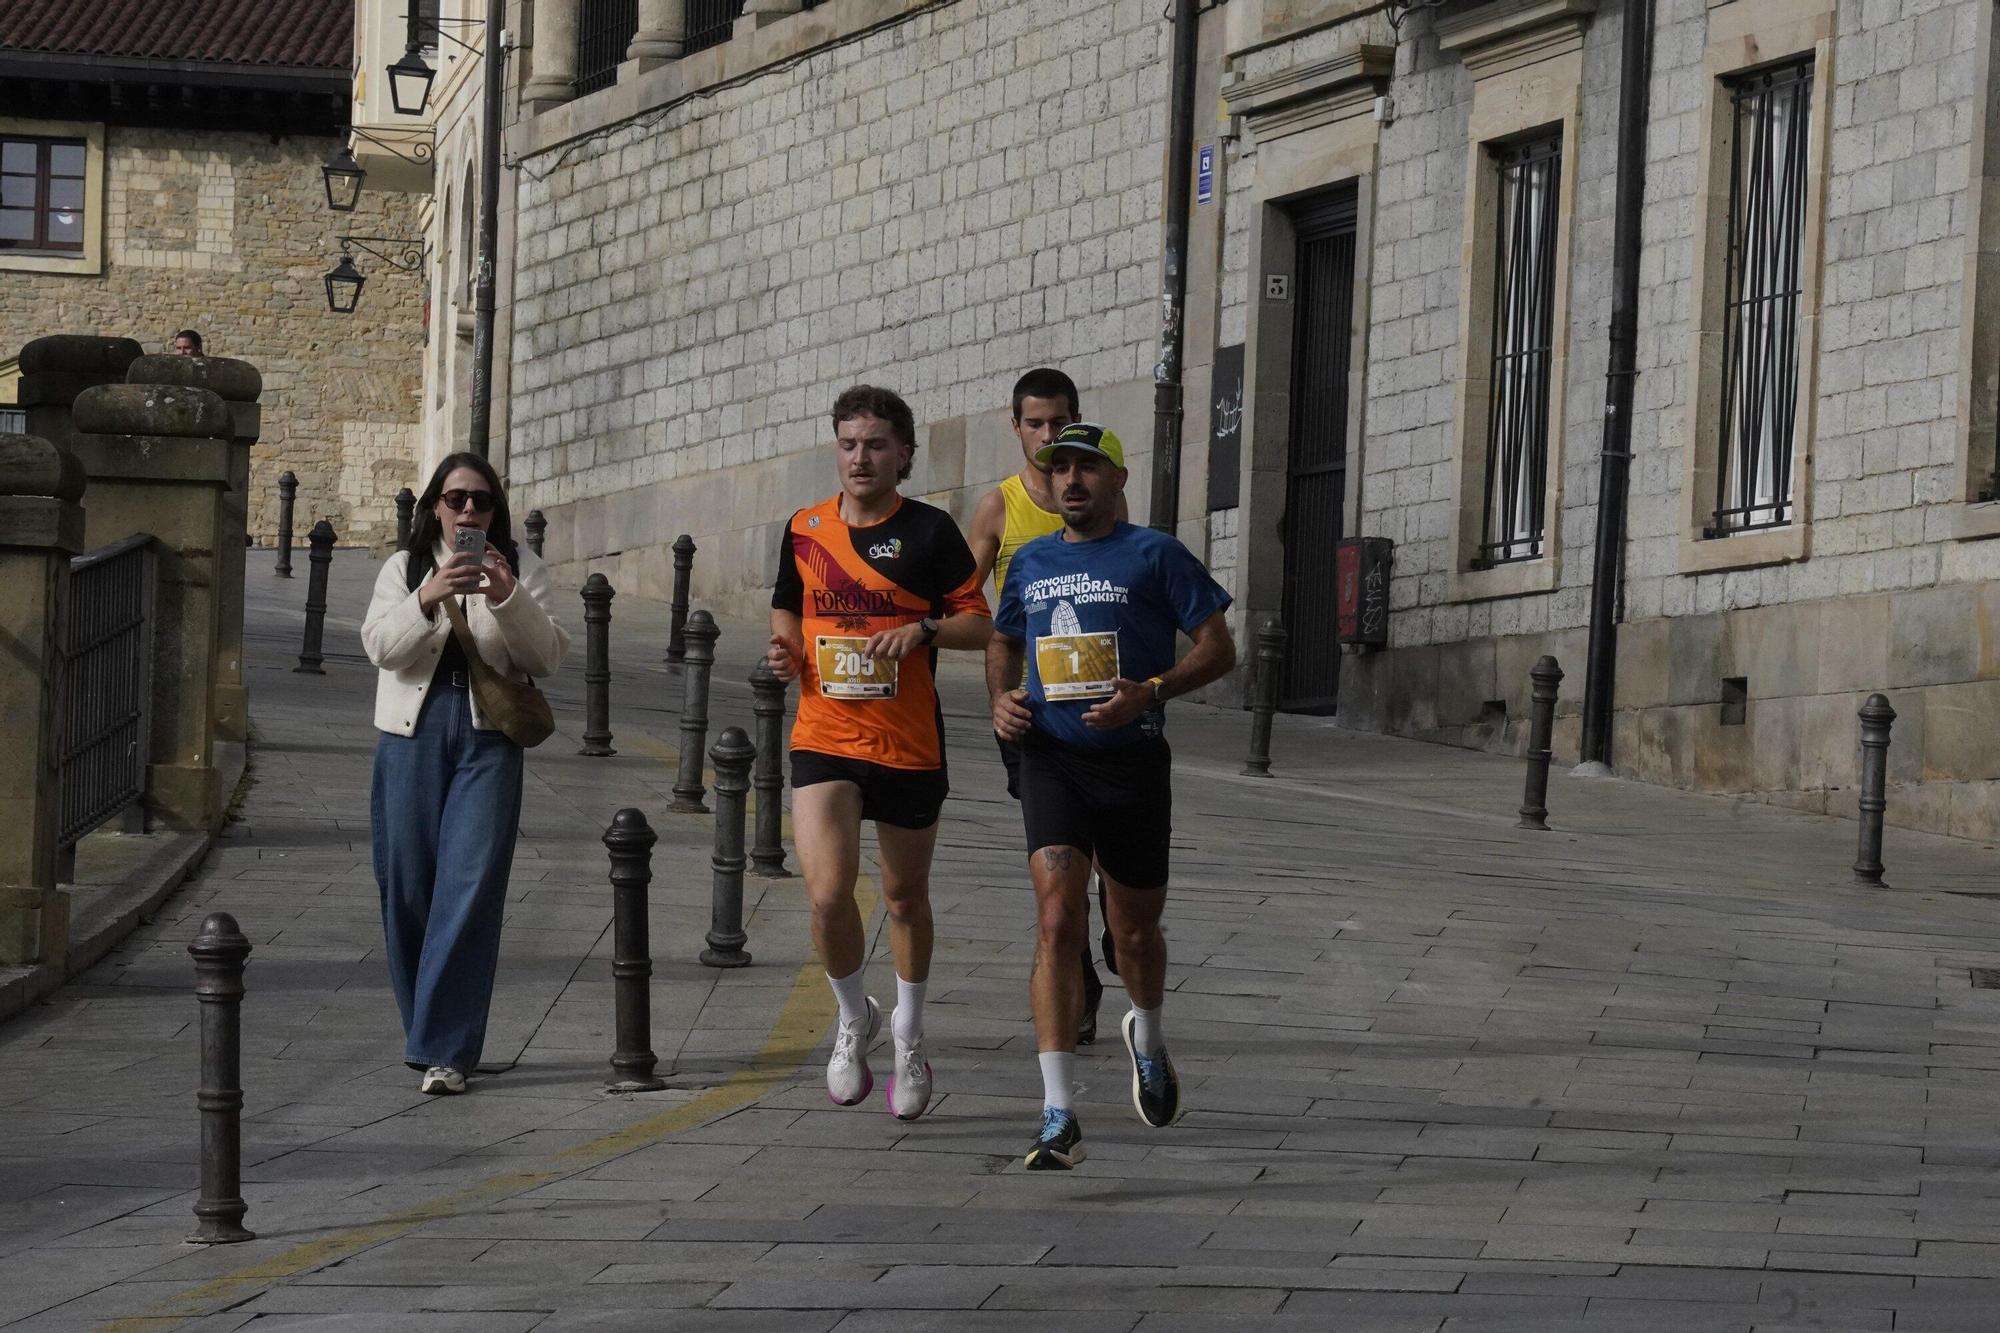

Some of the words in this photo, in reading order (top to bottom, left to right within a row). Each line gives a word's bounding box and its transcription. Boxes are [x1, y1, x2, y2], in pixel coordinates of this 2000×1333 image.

[1032, 573, 1089, 591] CONQUISTA
[1033, 580, 1113, 602] ALMENDRA
[812, 590, 895, 611] FORONDA
[1075, 592, 1128, 605] KONKISTA
[834, 652, 874, 676] 205
[1068, 651, 1078, 674] 1
